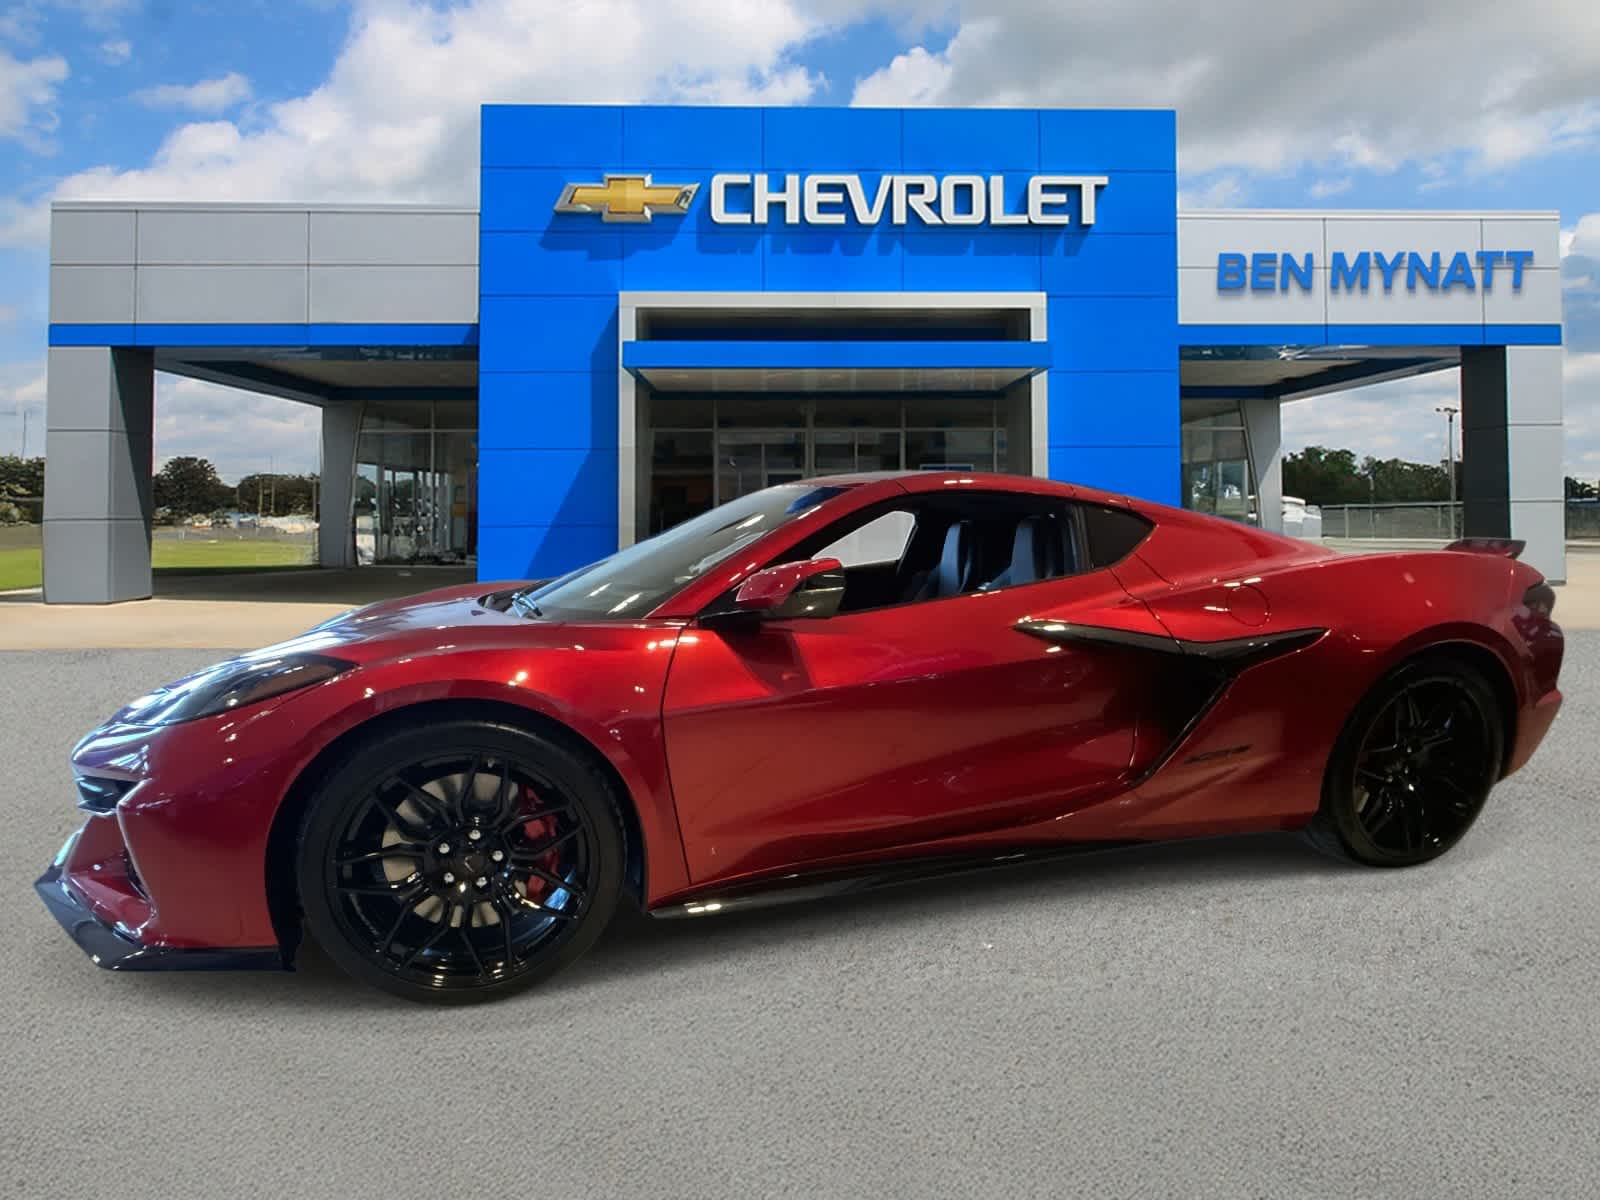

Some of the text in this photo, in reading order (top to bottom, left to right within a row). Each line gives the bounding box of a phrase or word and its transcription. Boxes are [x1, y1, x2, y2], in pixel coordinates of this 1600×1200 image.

[710, 173, 1109, 225] CHEVROLET
[1216, 250, 1535, 291] BEN MYNATT
